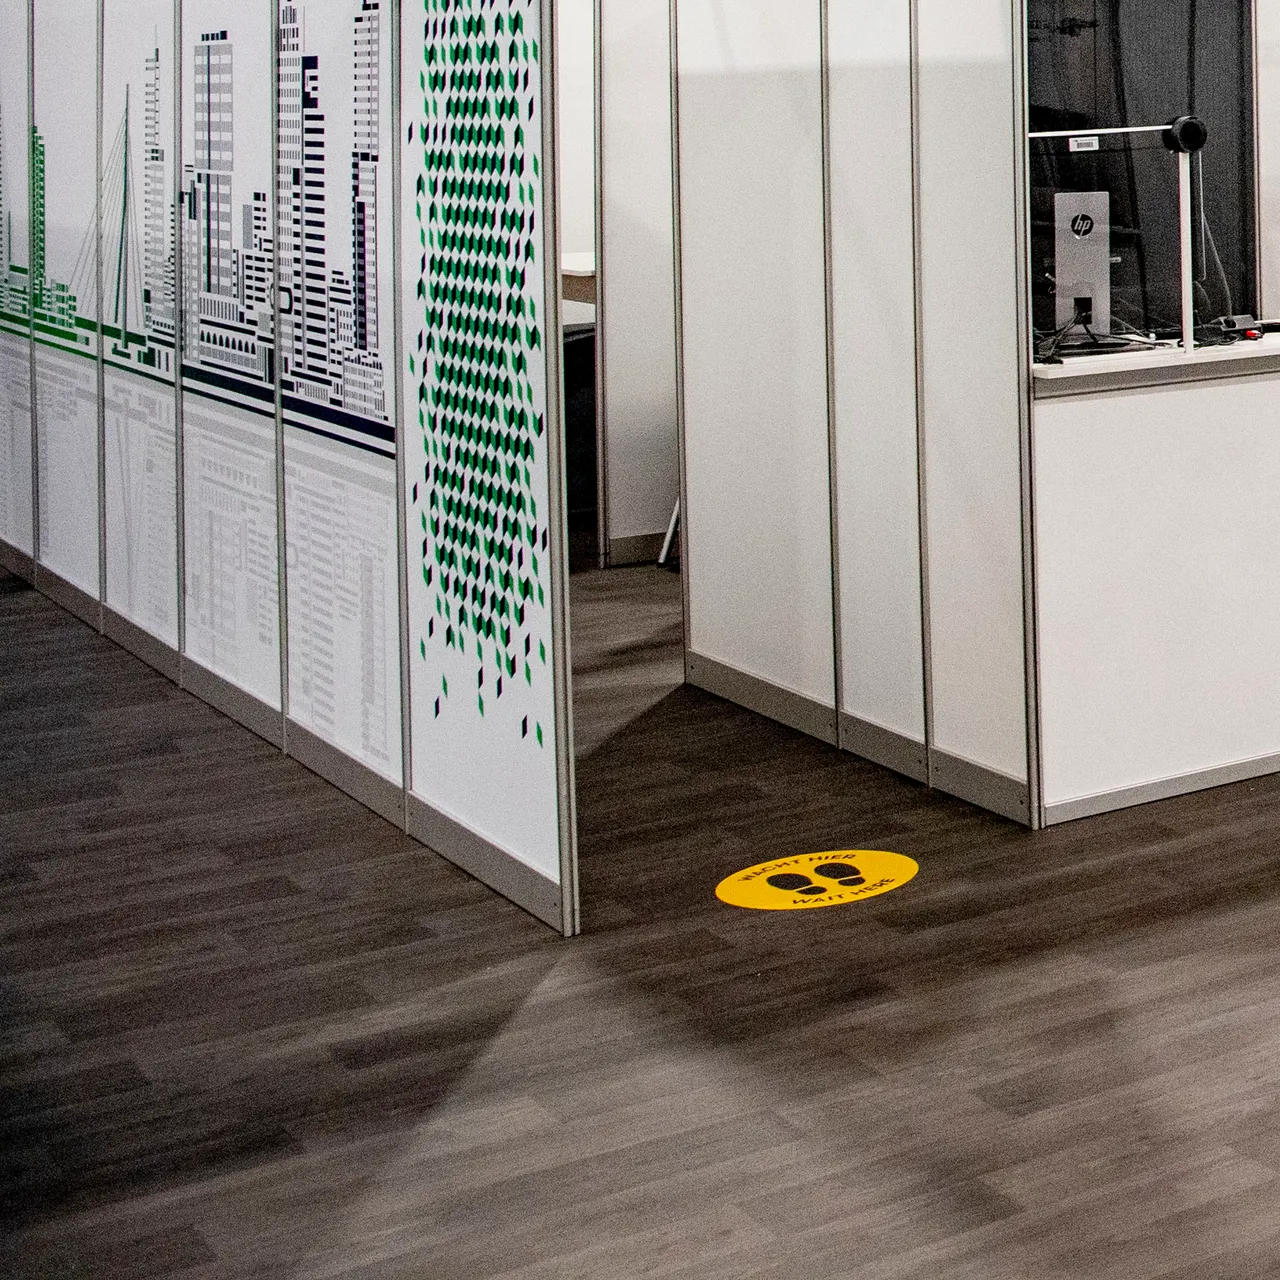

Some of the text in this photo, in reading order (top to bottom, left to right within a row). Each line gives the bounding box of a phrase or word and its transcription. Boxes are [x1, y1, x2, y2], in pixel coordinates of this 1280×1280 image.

[1072, 214, 1093, 236] hp
[738, 854, 856, 881] WACHT HIER
[792, 878, 895, 904] WAIT HERE
